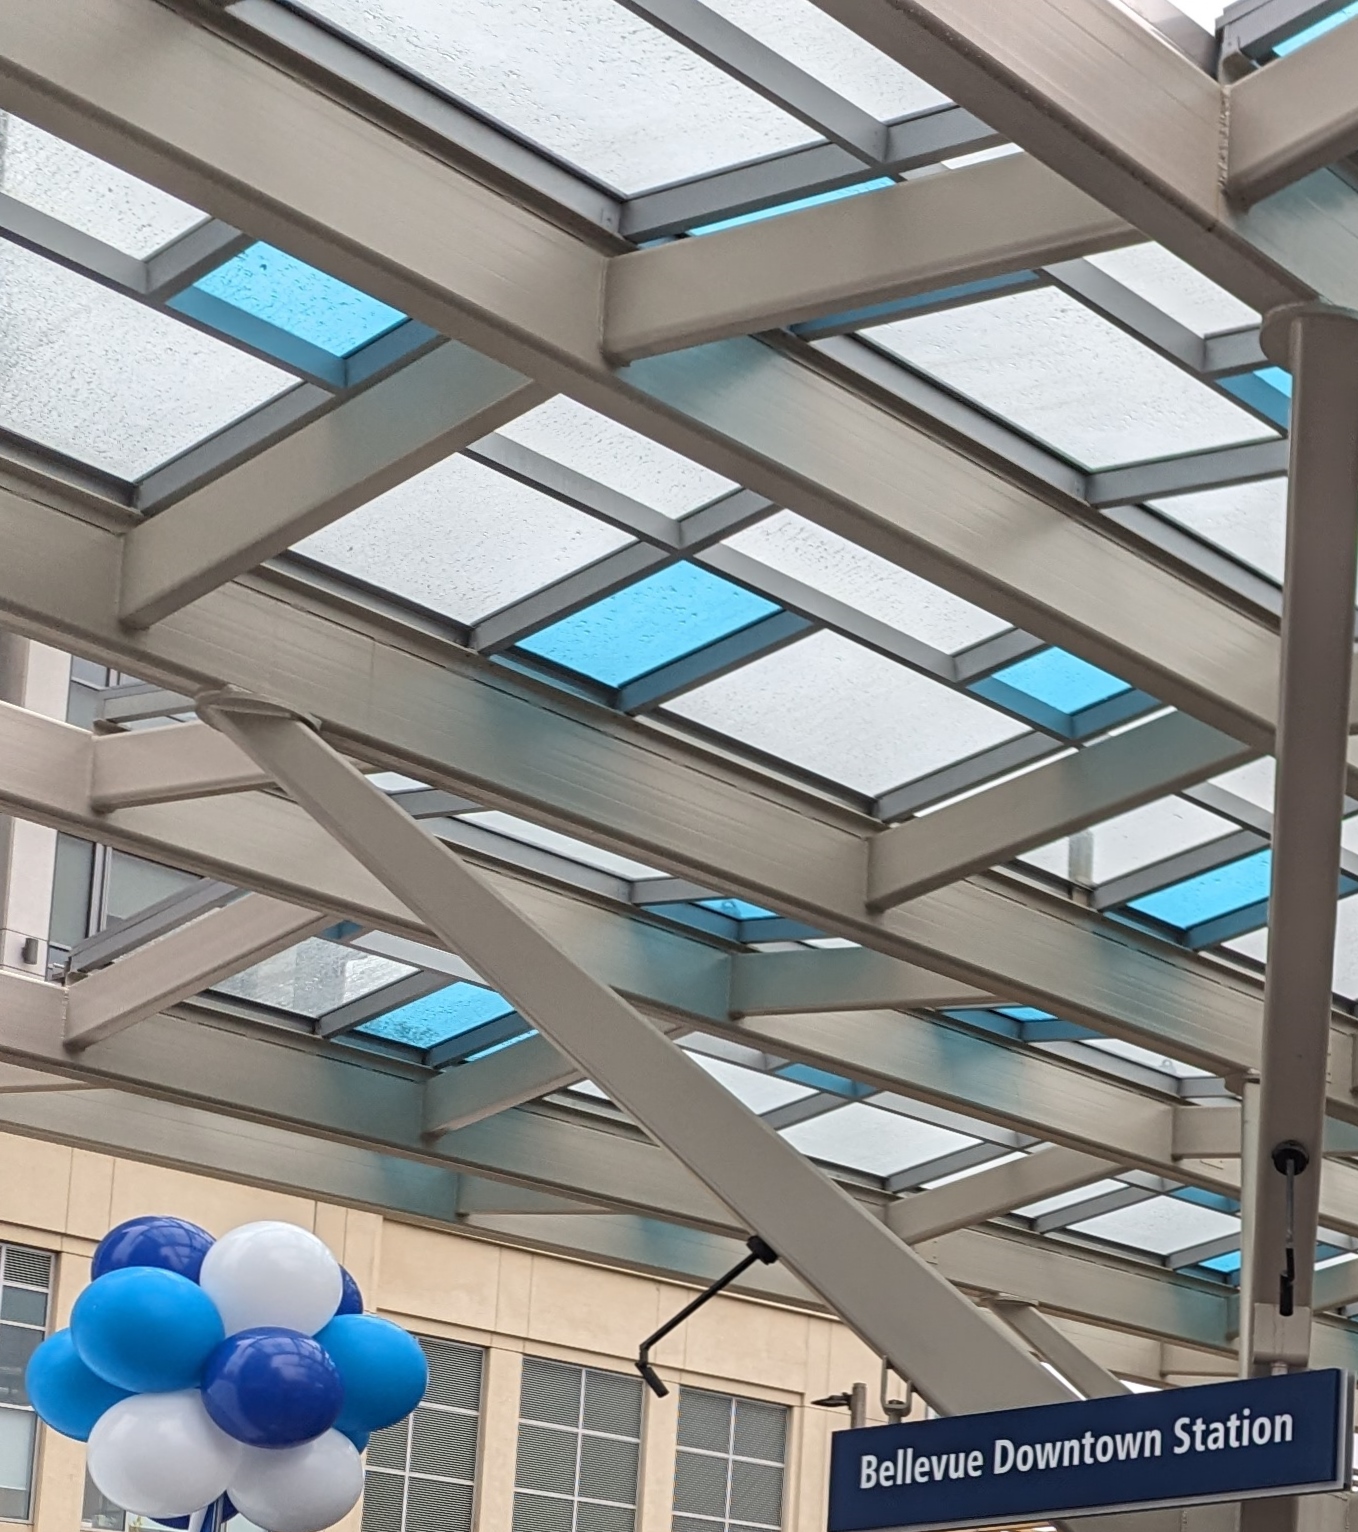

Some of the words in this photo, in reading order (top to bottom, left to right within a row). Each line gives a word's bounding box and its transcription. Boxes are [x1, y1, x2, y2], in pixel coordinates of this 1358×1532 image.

[859, 1447, 984, 1490] Bellevue
[993, 1429, 1163, 1475] Downtown
[1173, 1407, 1294, 1455] Station
